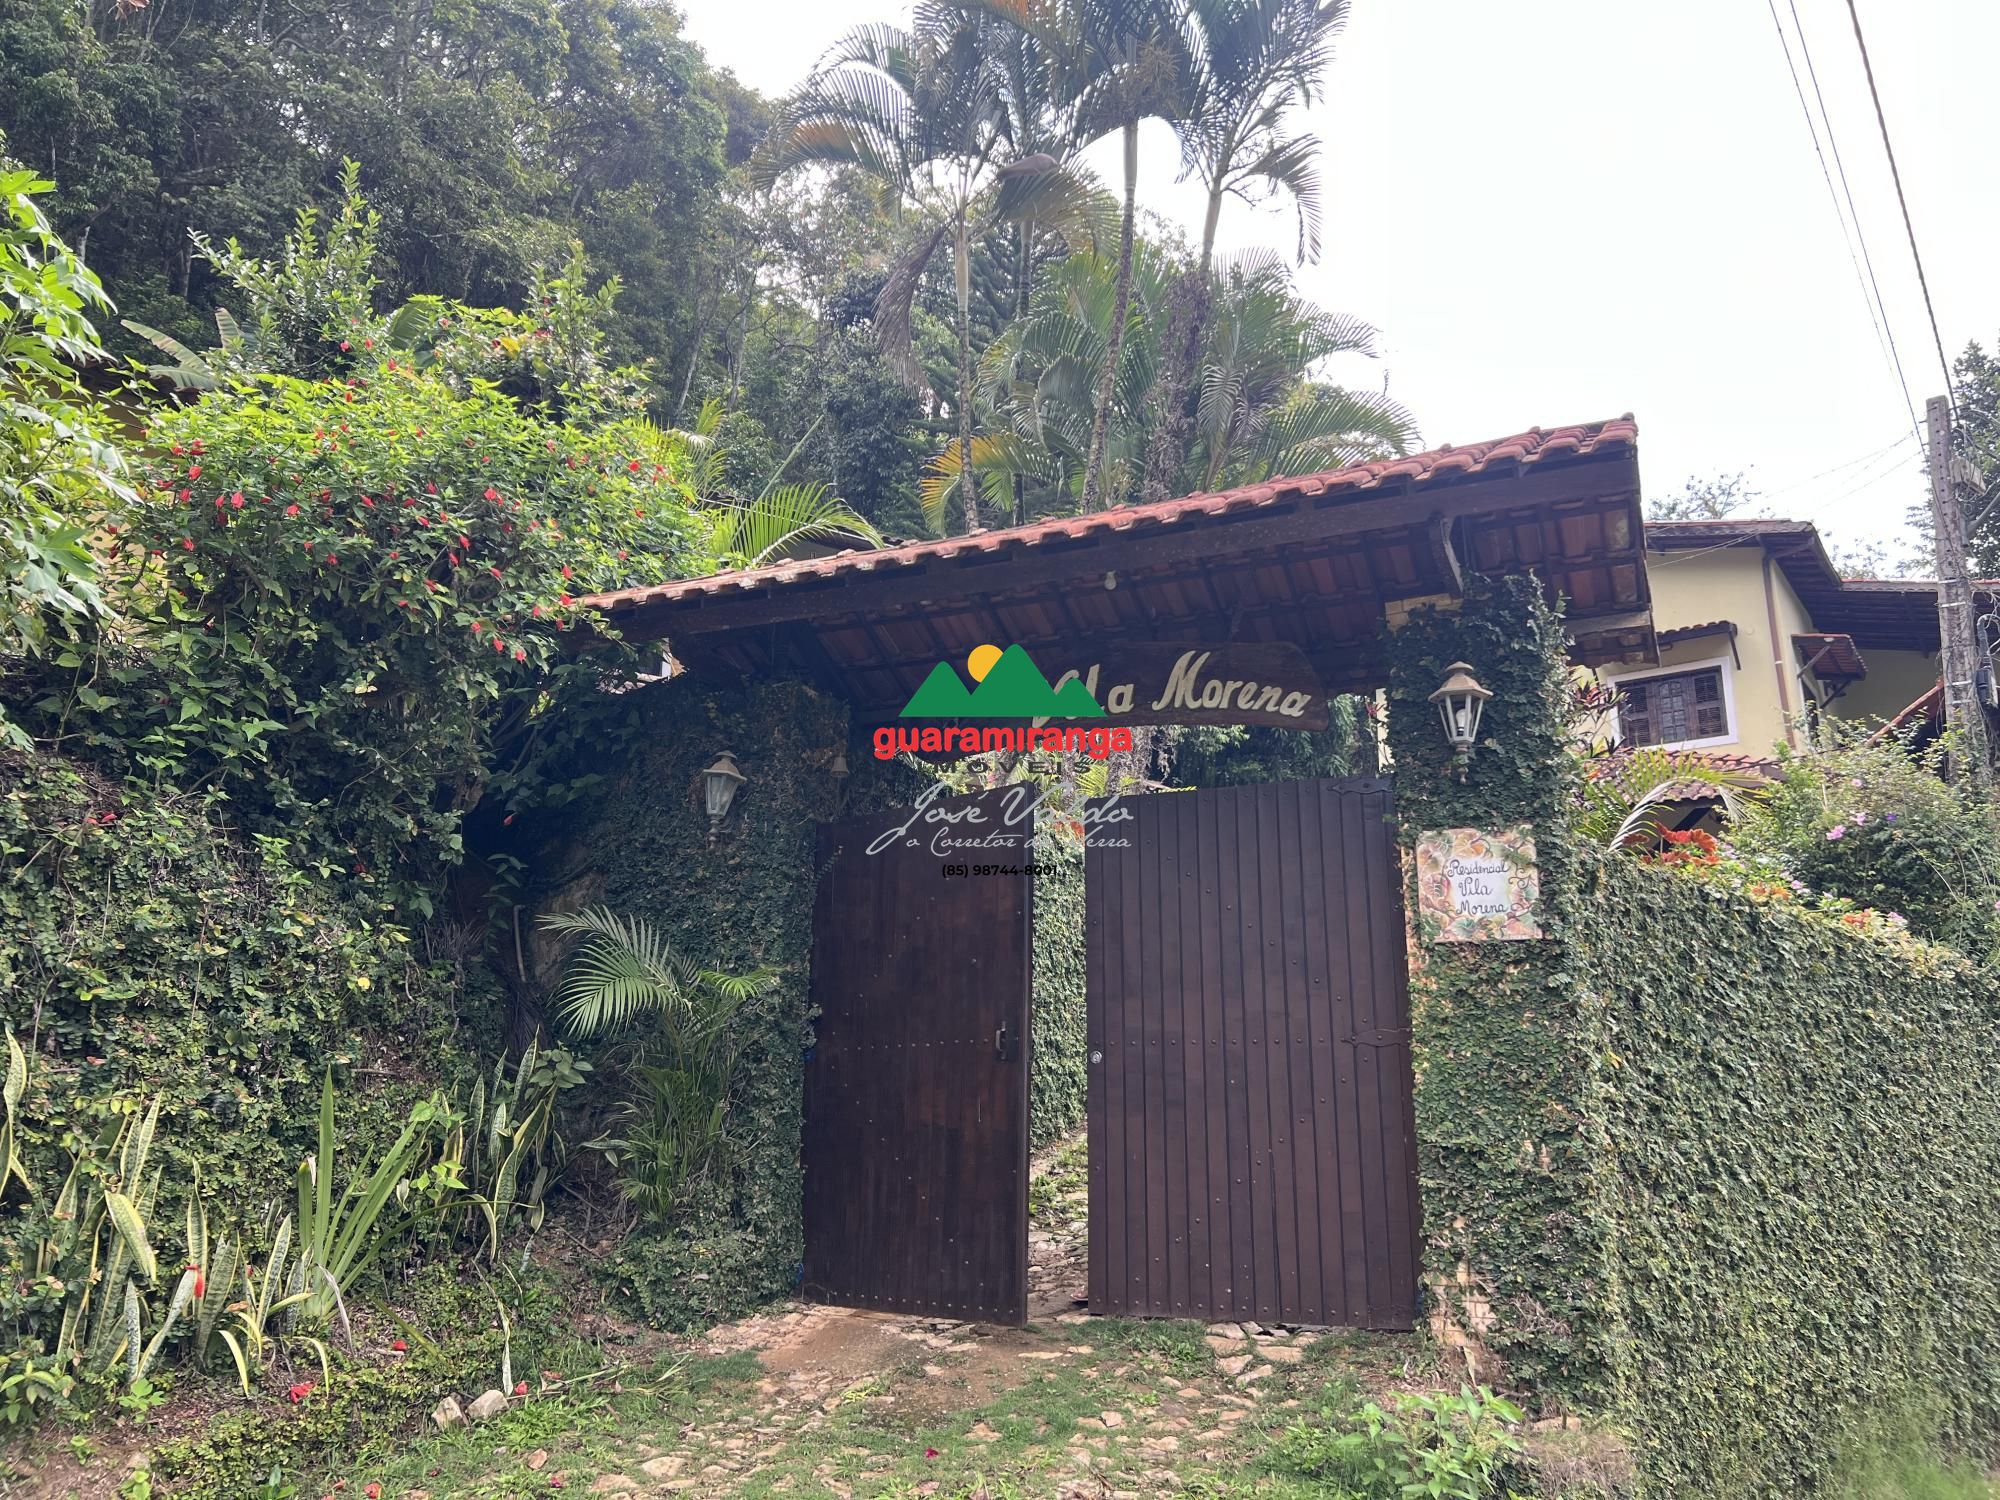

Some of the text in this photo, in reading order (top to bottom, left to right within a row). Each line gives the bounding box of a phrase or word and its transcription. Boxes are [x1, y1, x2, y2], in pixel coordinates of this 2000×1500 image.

[1151, 650, 1312, 718] Morena
[1447, 859, 1510, 877] Residencial
[1458, 877, 1494, 897] Vila
[1456, 900, 1509, 917] Morena
